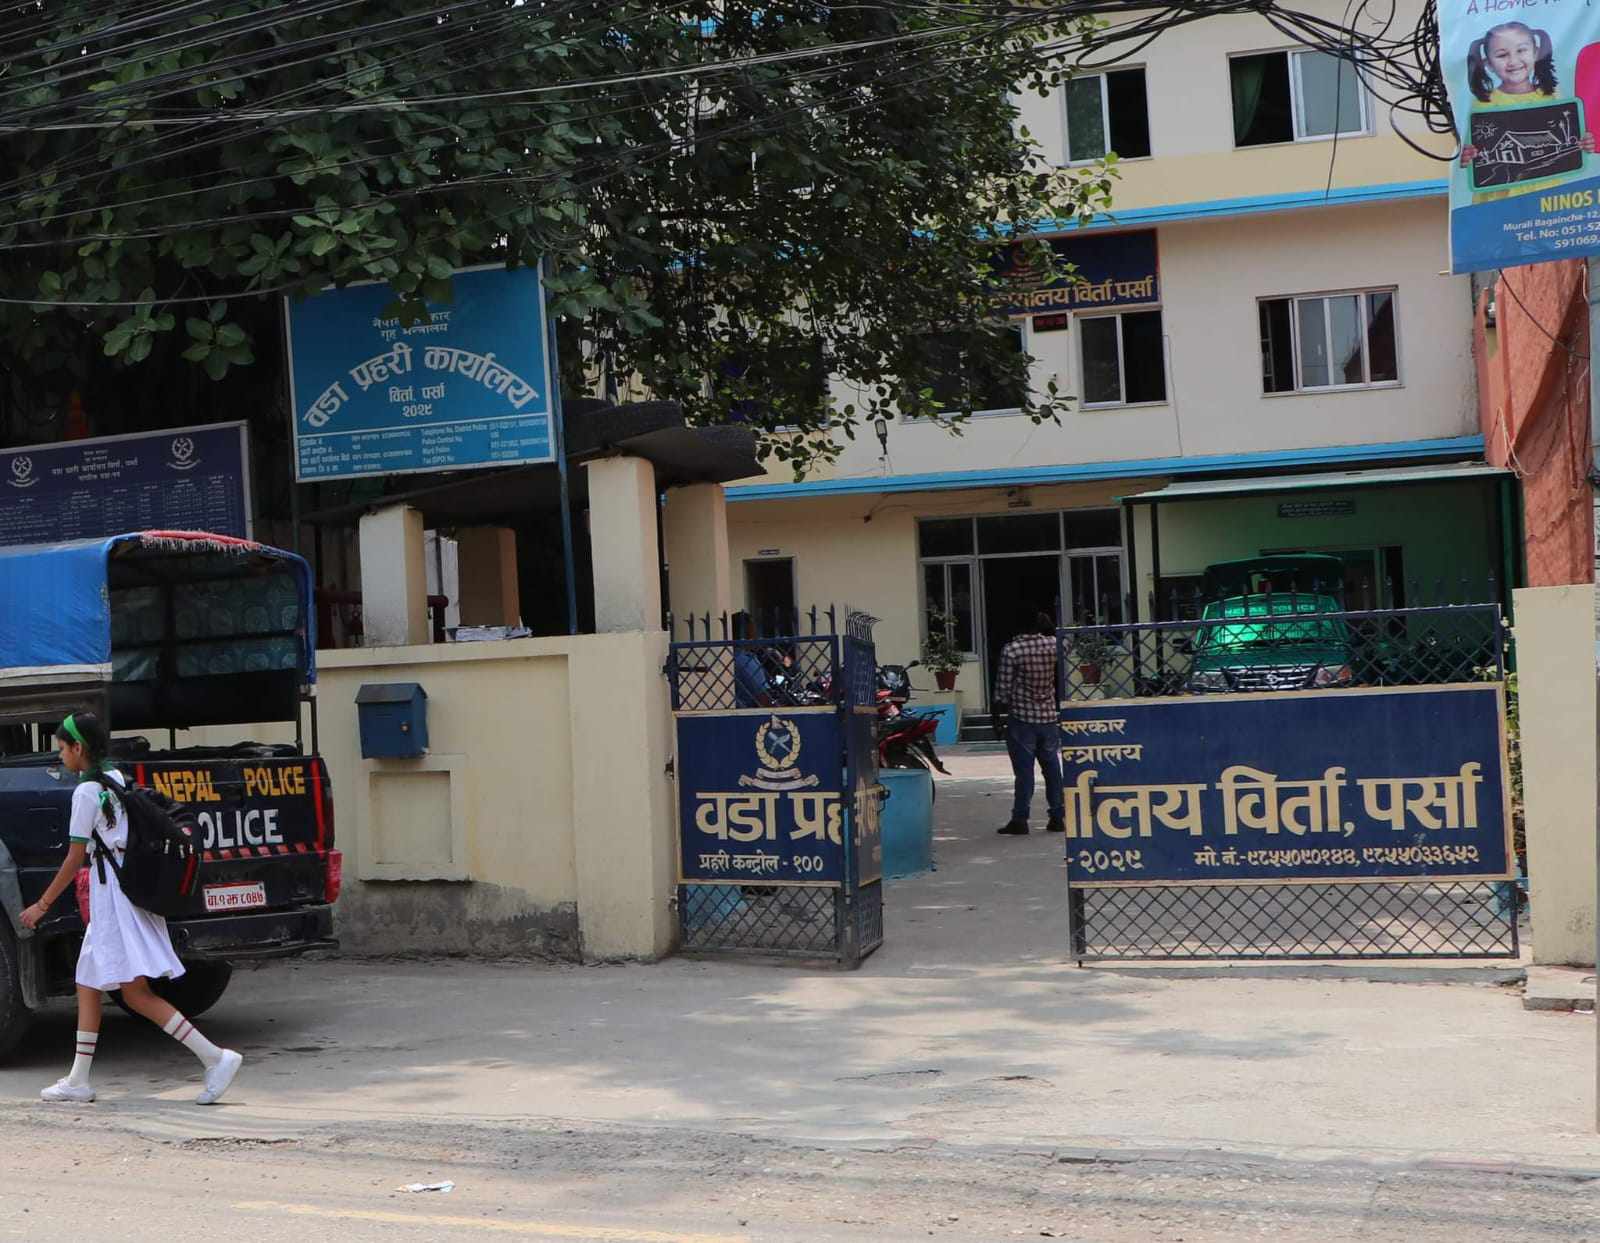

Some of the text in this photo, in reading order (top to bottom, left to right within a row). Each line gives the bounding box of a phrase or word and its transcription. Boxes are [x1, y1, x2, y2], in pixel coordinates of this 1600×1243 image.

[1541, 190, 1593, 213] NINOS
[1503, 220, 1534, 232] Murali
[1516, 231, 1537, 241] Tel.
[1540, 229, 1559, 238] No:
[1116, 275, 1154, 298] पर्सा
[303, 342, 540, 428] वडा प्रहरी कार्यालय
[1061, 719, 1127, 736] सरकार
[153, 766, 307, 802] NEPAL POLICE
[1216, 765, 1355, 837] विर्ता,
[1357, 761, 1483, 830] पर्सा
[696, 791, 780, 842] वडा
[698, 849, 730, 873] प्रहरी
[732, 849, 780, 875] कन्ट्रोल
[793, 855, 823, 873] १००
